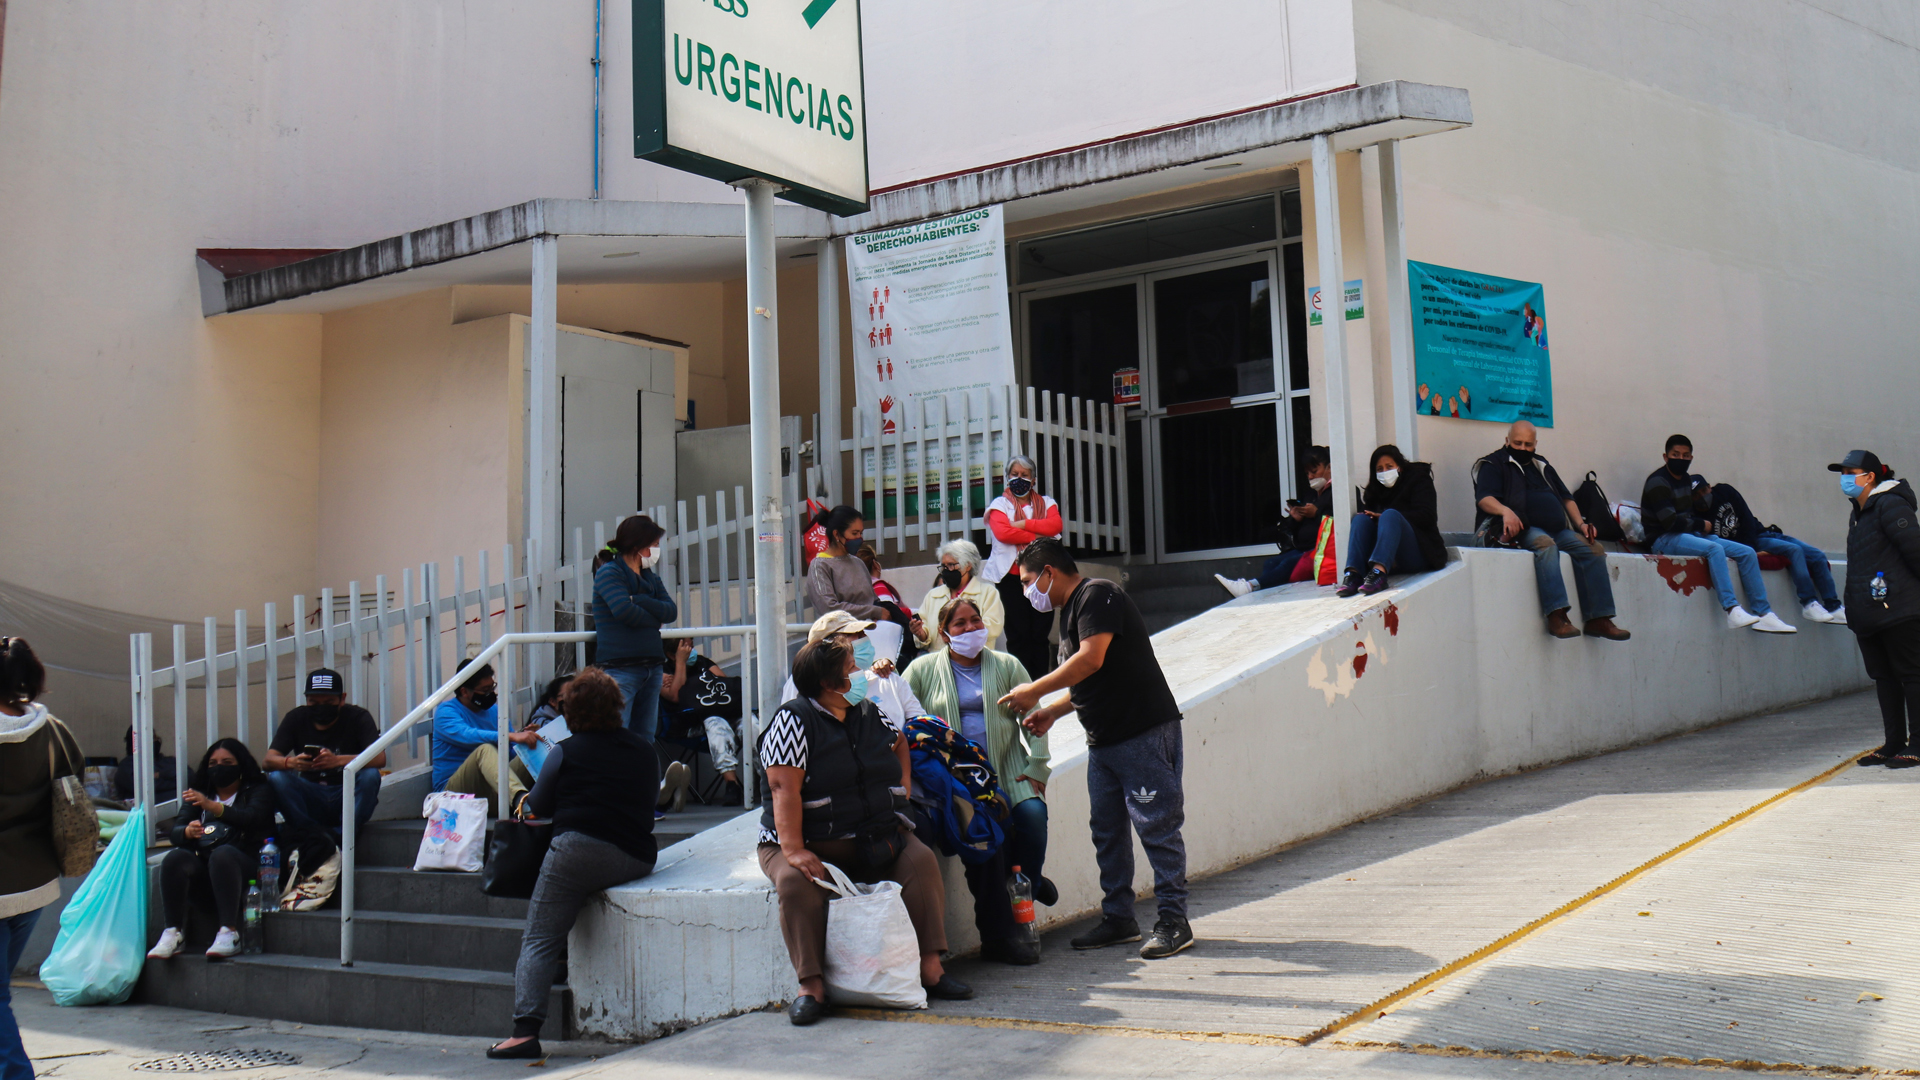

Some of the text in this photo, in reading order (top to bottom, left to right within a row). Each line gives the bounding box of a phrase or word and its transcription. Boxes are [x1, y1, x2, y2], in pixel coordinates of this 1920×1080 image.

[674, 33, 854, 141] URGENCIAS
[854, 209, 990, 246] ESTIMADAS Y ESTIMADOS
[866, 223, 980, 254] DERECHOHABIENTES:
[886, 262, 911, 273] implementa
[918, 257, 936, 265] Jornada
[959, 248, 980, 256] Distancia
[919, 250, 946, 259] establecidos
[892, 267, 910, 275] medidas
[911, 262, 937, 273] emergentes
[921, 280, 955, 292] aglomeraciones
[935, 284, 963, 294] acompañante
[1421, 284, 1440, 294] porque
[1458, 279, 1473, 287] darles
[1481, 283, 1504, 292] GRACIAS
[1437, 297, 1454, 305] motivo
[1455, 301, 1466, 309] para
[1493, 307, 1503, 315] que
[1442, 309, 1452, 317] por
[1460, 310, 1477, 318] familia
[1424, 318, 1433, 326] por
[1434, 318, 1448, 326] todos
[1456, 321, 1478, 330] enfermos
[921, 327, 941, 336] requieren
[1442, 334, 1461, 343] Nuestro
[1462, 337, 1478, 346] eterno
[1478, 340, 1511, 352] agradecimiento
[915, 356, 932, 364] espacio
[1427, 345, 1450, 355] Personal
[1451, 348, 1458, 356] de
[1458, 349, 1476, 360] Terapia
[1476, 352, 1498, 363] Intensiva,
[1498, 354, 1513, 363] unidad
[1453, 359, 1473, 369] personal
[1480, 363, 1507, 374] Laboratorio,
[1507, 367, 1524, 376] trabajo
[1485, 373, 1505, 384] personal
[1511, 376, 1537, 386] Enfermería
[1500, 385, 1519, 395] personal
